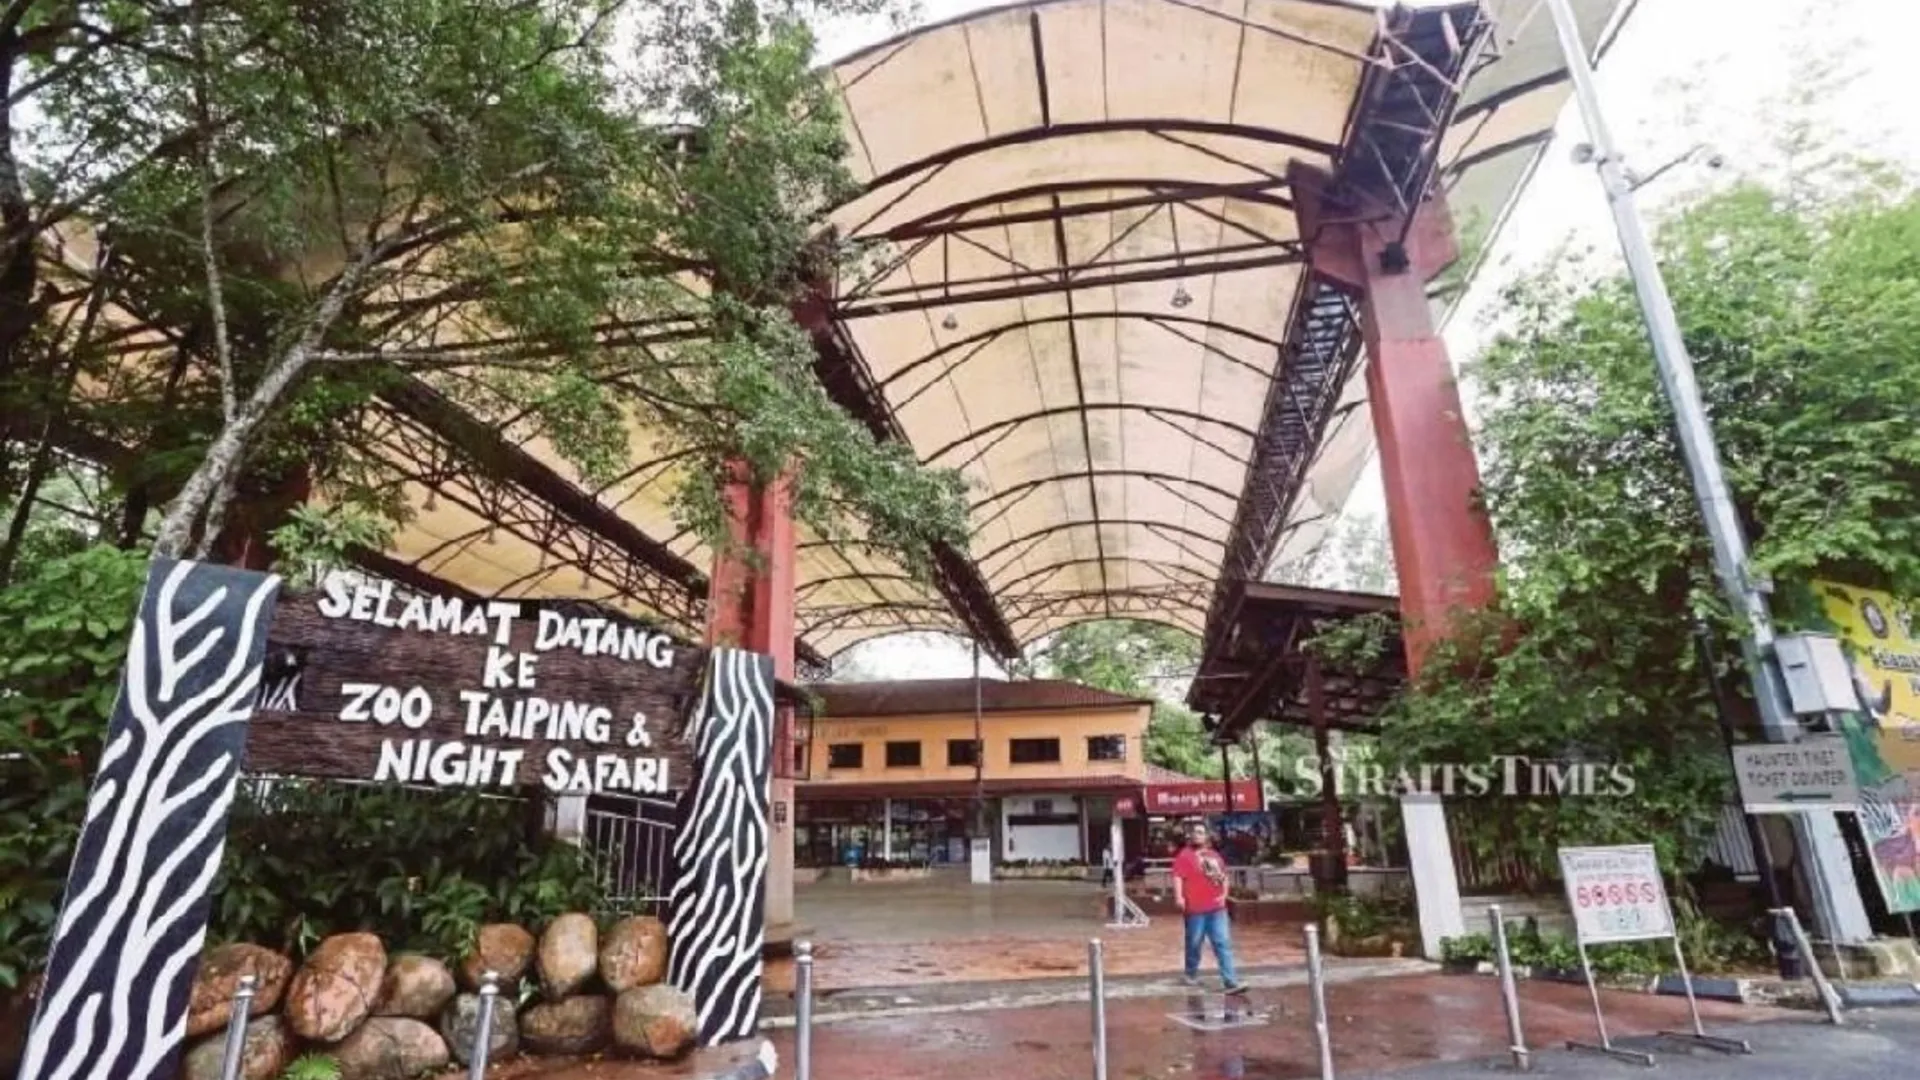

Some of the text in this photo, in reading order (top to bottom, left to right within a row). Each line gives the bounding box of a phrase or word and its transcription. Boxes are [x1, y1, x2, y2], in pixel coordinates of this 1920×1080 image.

[318, 573, 674, 668] SELAMAT DATANG
[483, 646, 539, 689] KE
[340, 683, 650, 747] ZOO TAIPING &
[374, 739, 669, 793] NIGHT SAFARI
